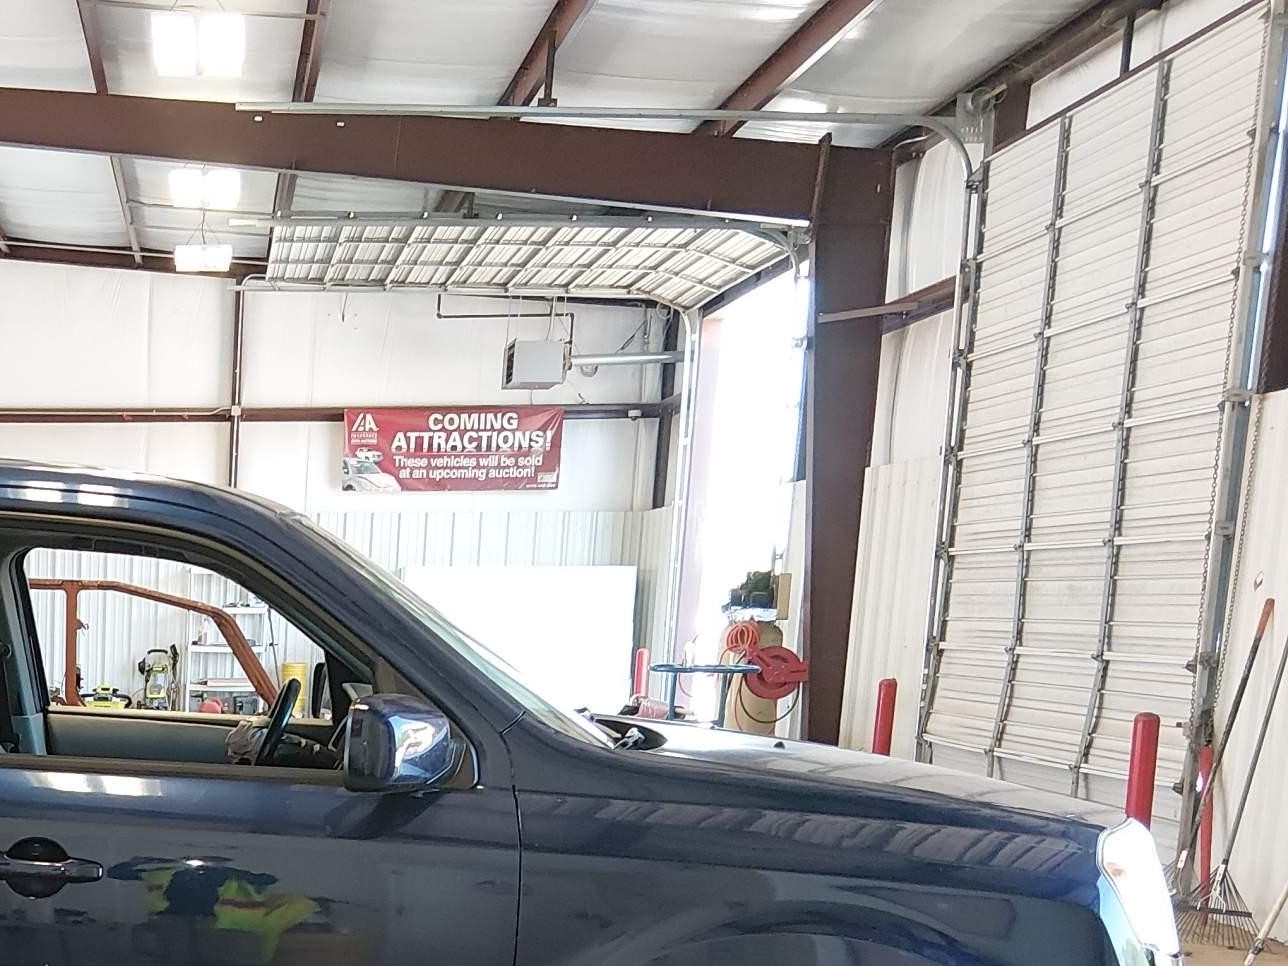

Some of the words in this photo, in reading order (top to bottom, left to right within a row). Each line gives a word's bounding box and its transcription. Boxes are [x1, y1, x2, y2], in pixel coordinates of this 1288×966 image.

[428, 412, 519, 430] COMING
[391, 430, 553, 452] ATTRACTIONS!
[393, 456, 428, 467] These
[430, 456, 477, 467] vehicles
[479, 455, 498, 467] will
[500, 455, 516, 466] be
[517, 454, 544, 466] sold
[399, 468, 411, 479] at
[412, 469, 427, 479] an
[429, 467, 487, 481] upcoming
[488, 466, 536, 478] auction!
